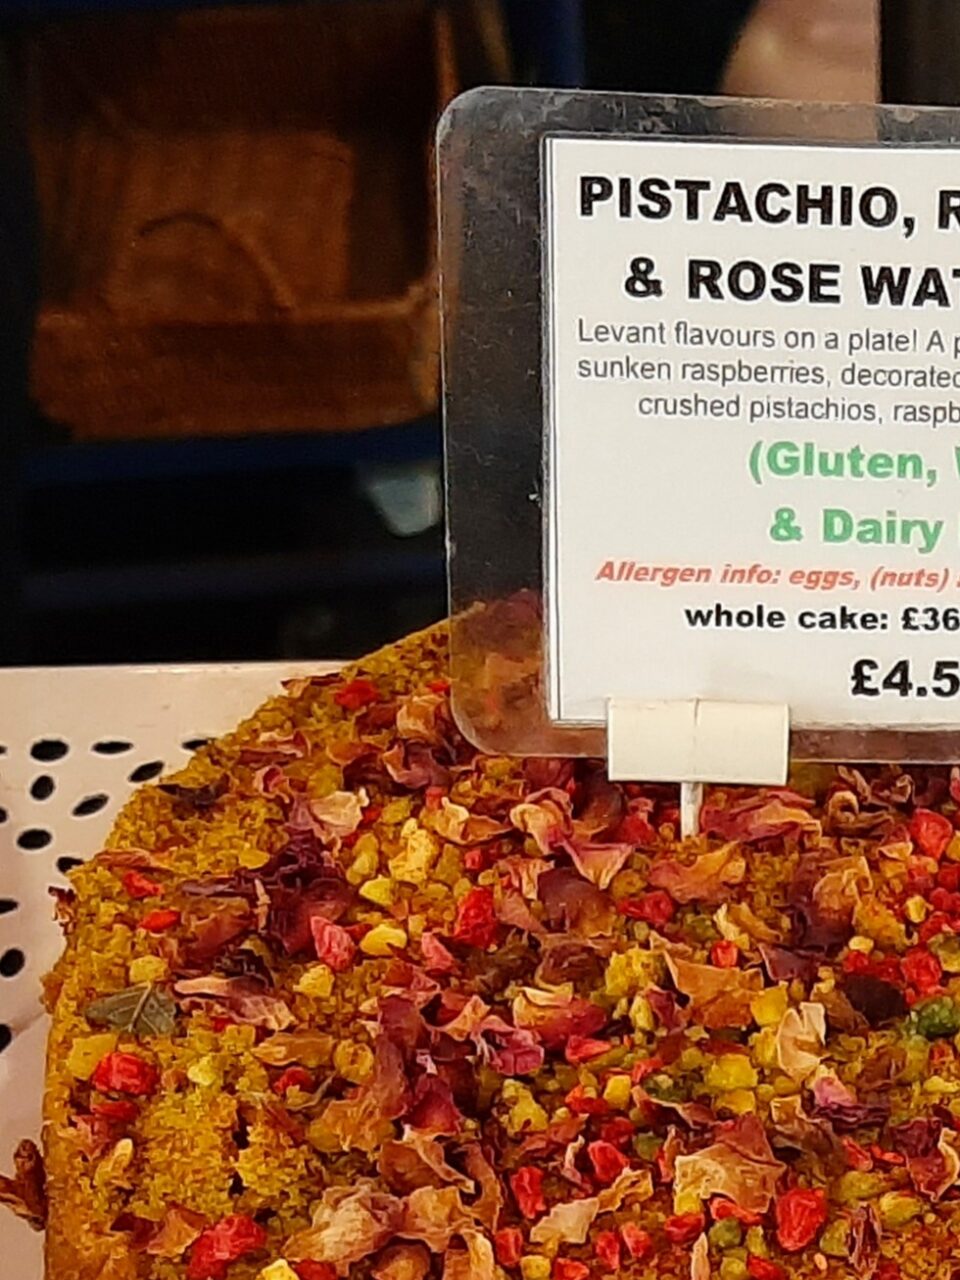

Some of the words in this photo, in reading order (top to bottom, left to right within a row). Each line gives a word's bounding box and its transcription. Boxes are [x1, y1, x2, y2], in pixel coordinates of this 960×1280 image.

[580, 175, 915, 239] PISTACHIO,
[624, 256, 663, 298] &
[688, 259, 841, 304] ROSE
[579, 318, 666, 345] Levant
[674, 321, 775, 348] flavours
[784, 330, 815, 349] on
[824, 332, 839, 350] a
[848, 326, 917, 356] plate!
[926, 329, 945, 353] A
[578, 355, 671, 381] sunken
[681, 358, 831, 389] raspberries,
[639, 392, 740, 417] crushed
[750, 394, 882, 424] pistachios,
[749, 441, 936, 487] (Gluten,
[770, 507, 803, 541] &
[823, 509, 944, 554] Dairy
[595, 561, 712, 587] Allergen
[720, 564, 781, 584] info:
[789, 570, 860, 590] eggs,
[870, 566, 949, 592] (nuts)
[684, 603, 786, 628] whole
[798, 605, 888, 631] cake:
[901, 607, 960, 631] £36
